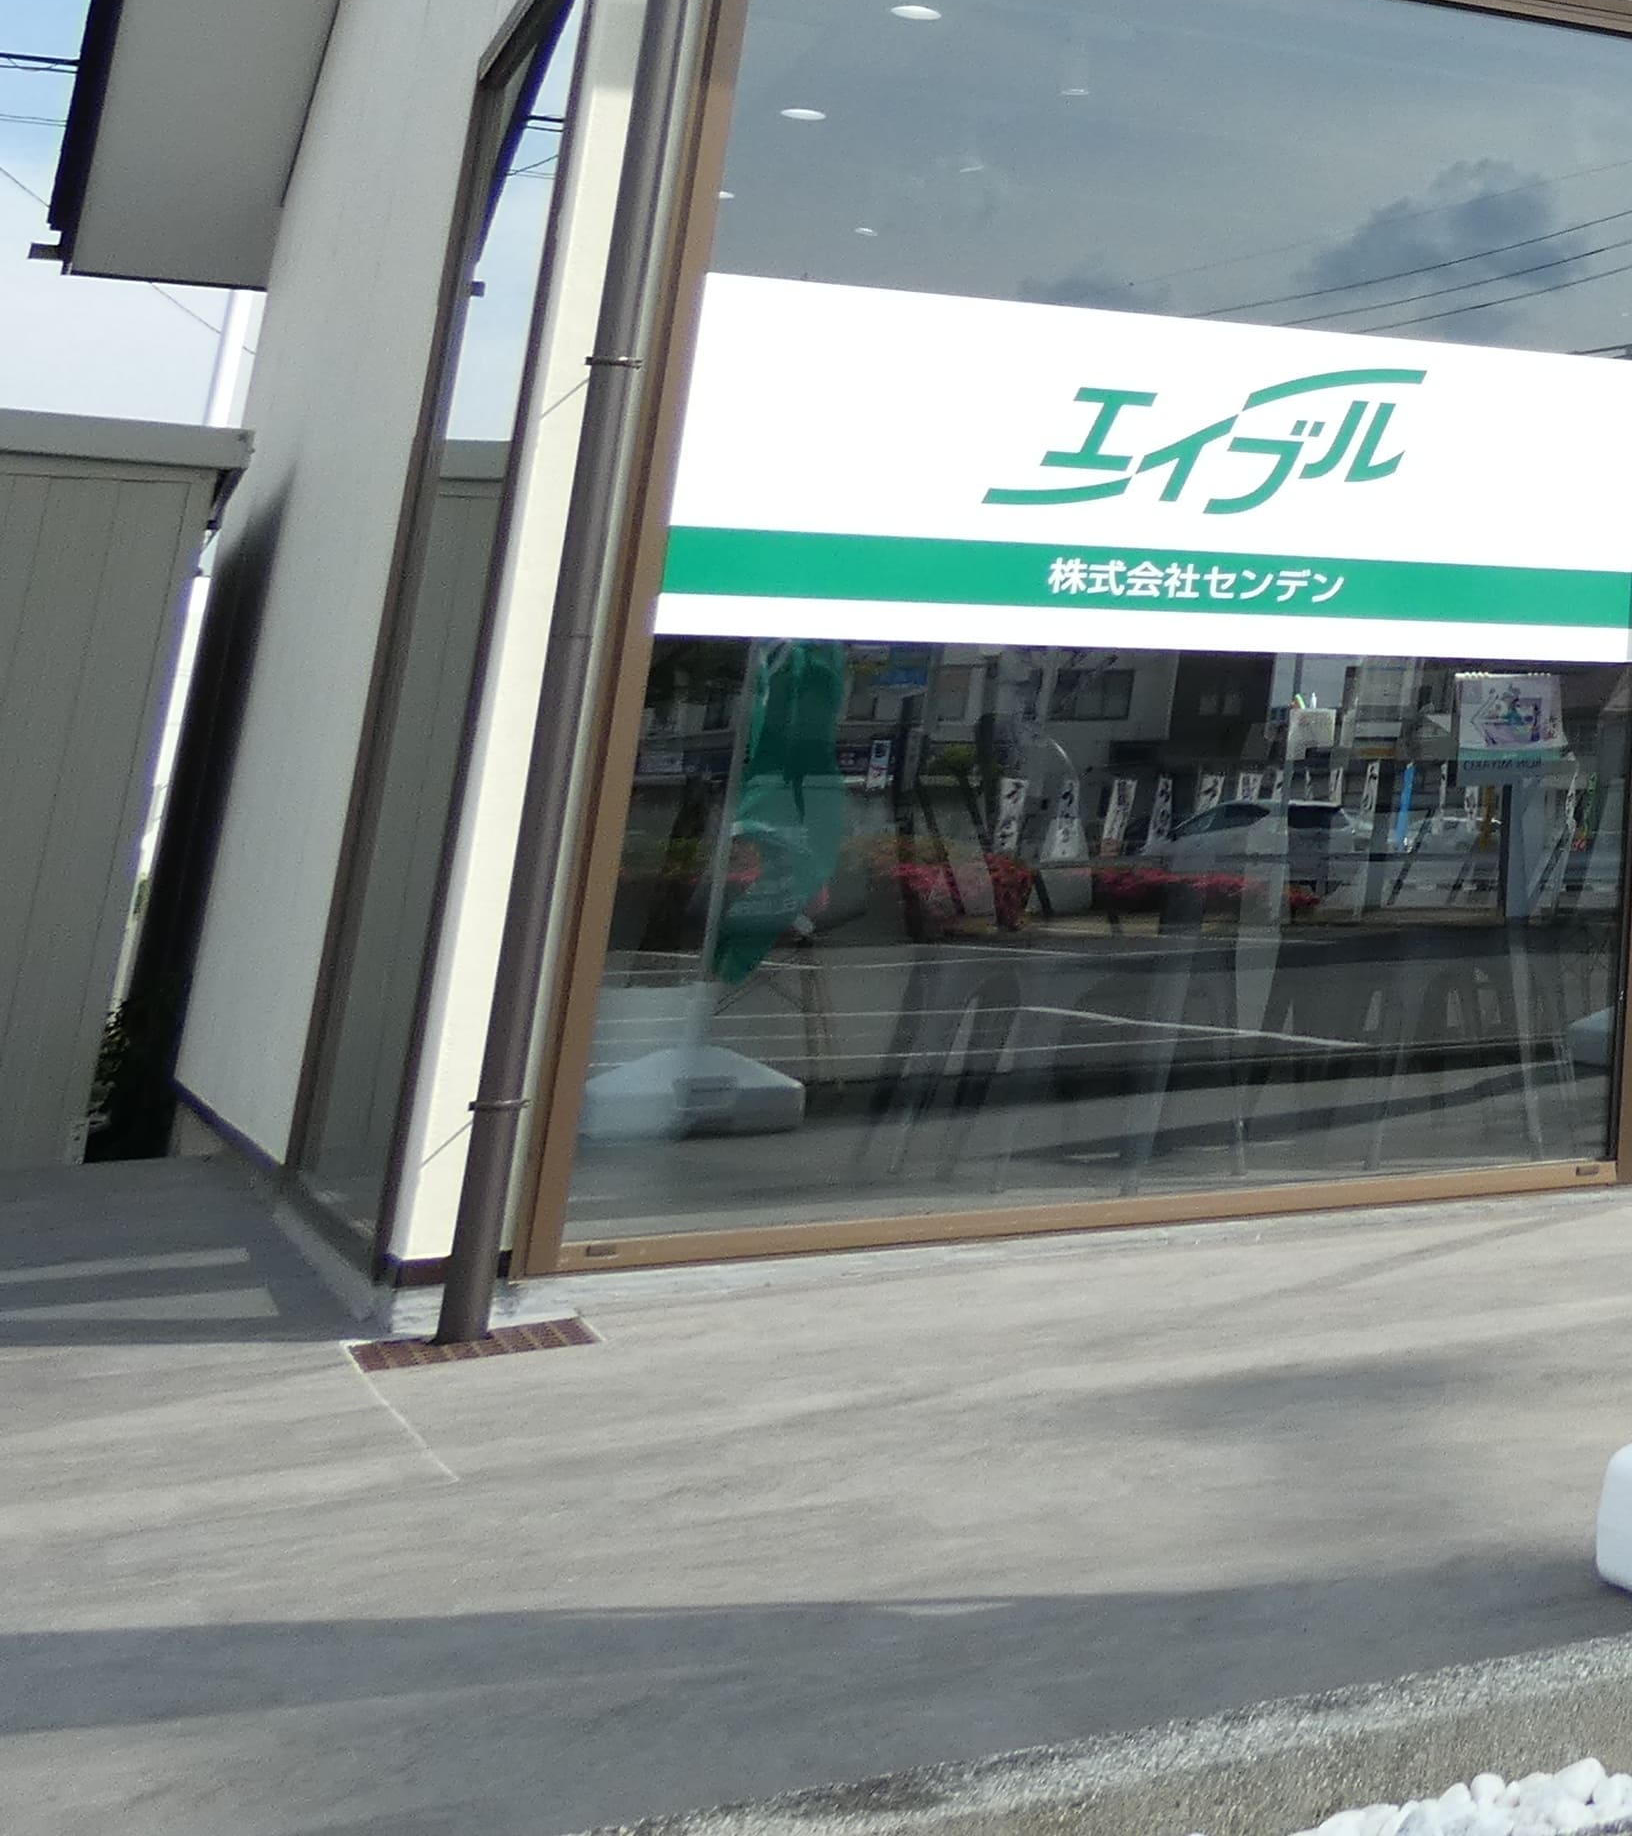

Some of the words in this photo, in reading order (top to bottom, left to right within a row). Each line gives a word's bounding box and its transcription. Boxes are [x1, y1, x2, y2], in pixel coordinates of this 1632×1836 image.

[981, 368, 1427, 515] エイブル
[1048, 557, 1345, 604] 株式会社センデン
